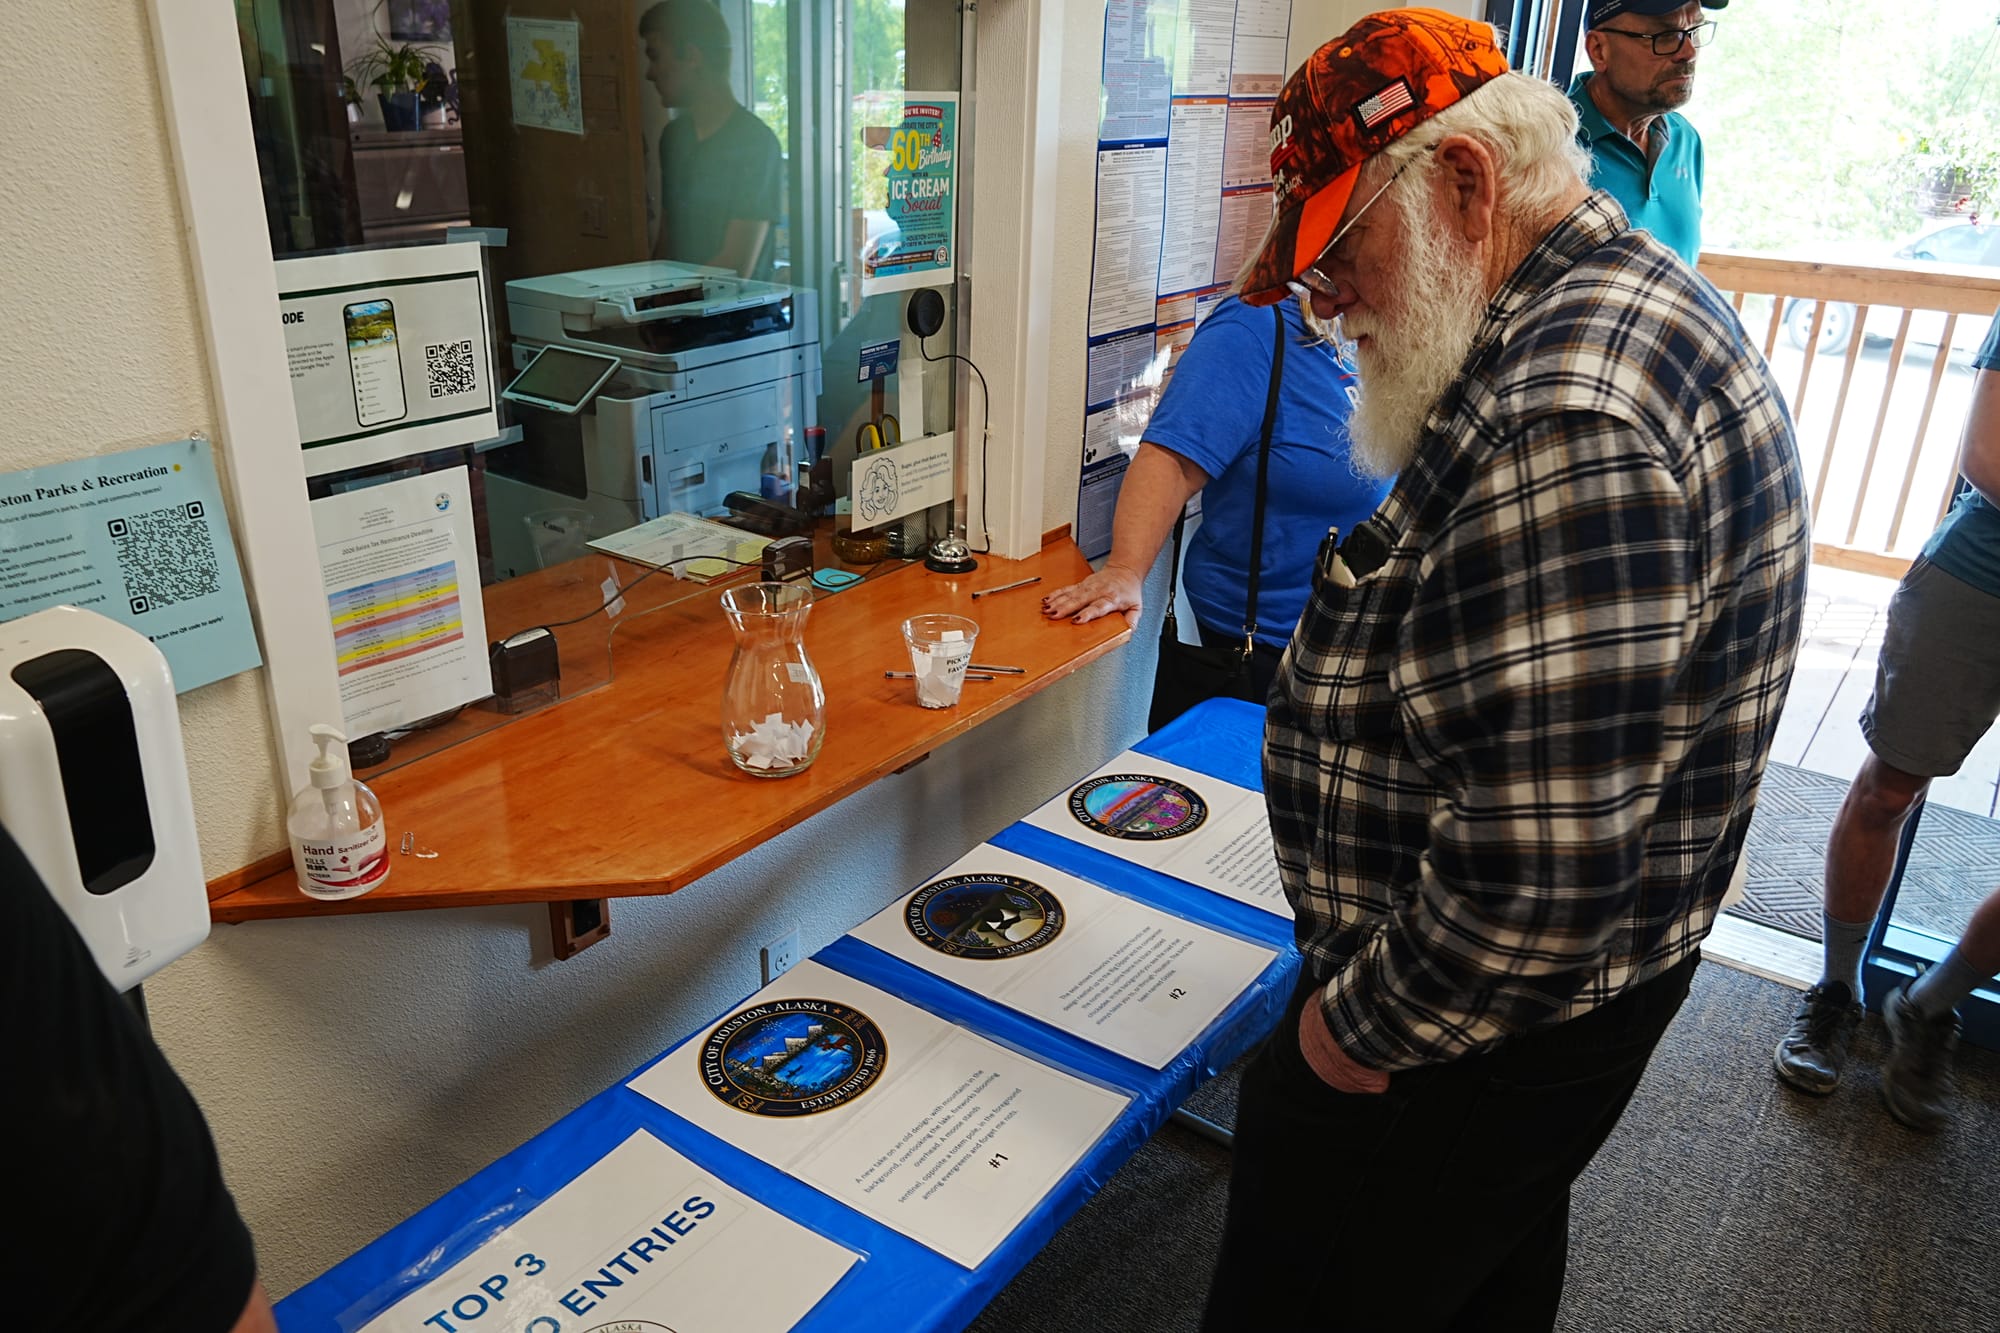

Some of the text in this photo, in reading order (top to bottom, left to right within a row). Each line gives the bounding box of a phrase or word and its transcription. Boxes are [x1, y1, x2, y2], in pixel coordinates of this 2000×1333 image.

[919, 143, 951, 170] Birthday
[892, 177, 950, 200] ICE CREAM
[902, 192, 943, 214] Social
[35, 483, 78, 501] Parks
[82, 478, 94, 492] &
[98, 464, 168, 488] Recreation
[1114, 774, 1154, 782] ALASKA
[1072, 799, 1081, 808] OF
[1074, 808, 1092, 822] CITY
[302, 844, 334, 856] Hand
[338, 840, 369, 854] Sanitizer
[910, 876, 1009, 936] CITY OF HOUSTON, ALASKA
[997, 924, 1052, 954] ESTABLISHED
[1169, 988, 1186, 1000] #2
[706, 1002, 828, 1086] CITY OF HOUSTON, ALASKA
[801, 1069, 870, 1110] ESTABLISHED
[864, 1048, 876, 1067] 1966
[861, 1167, 875, 1178] new
[874, 1156, 887, 1167] take
[901, 1132, 912, 1141] old
[911, 1116, 932, 1133] design,
[930, 1105, 943, 1115] with
[941, 1082, 969, 1105] mountains
[864, 1072, 1000, 1193] background, overlooking the lake, fireworks blooming
[912, 1141, 942, 1167] overhead.
[945, 1121, 963, 1137] moose
[962, 1105, 980, 1120] stands
[921, 1157, 949, 1181] opposite
[950, 1138, 968, 1154] totem
[966, 1126, 980, 1139] pole,
[984, 1113, 994, 1121] the
[992, 1088, 1022, 1113] foreground
[922, 1181, 943, 1199] among
[940, 1153, 973, 1182] evergreens
[969, 1143, 981, 1153] and
[979, 1128, 998, 1144] forget
[995, 1120, 1005, 1128] me
[988, 1153, 1008, 1168] #1
[558, 1195, 716, 1316] ENTRIES
[423, 1252, 546, 1333] TOP 3
